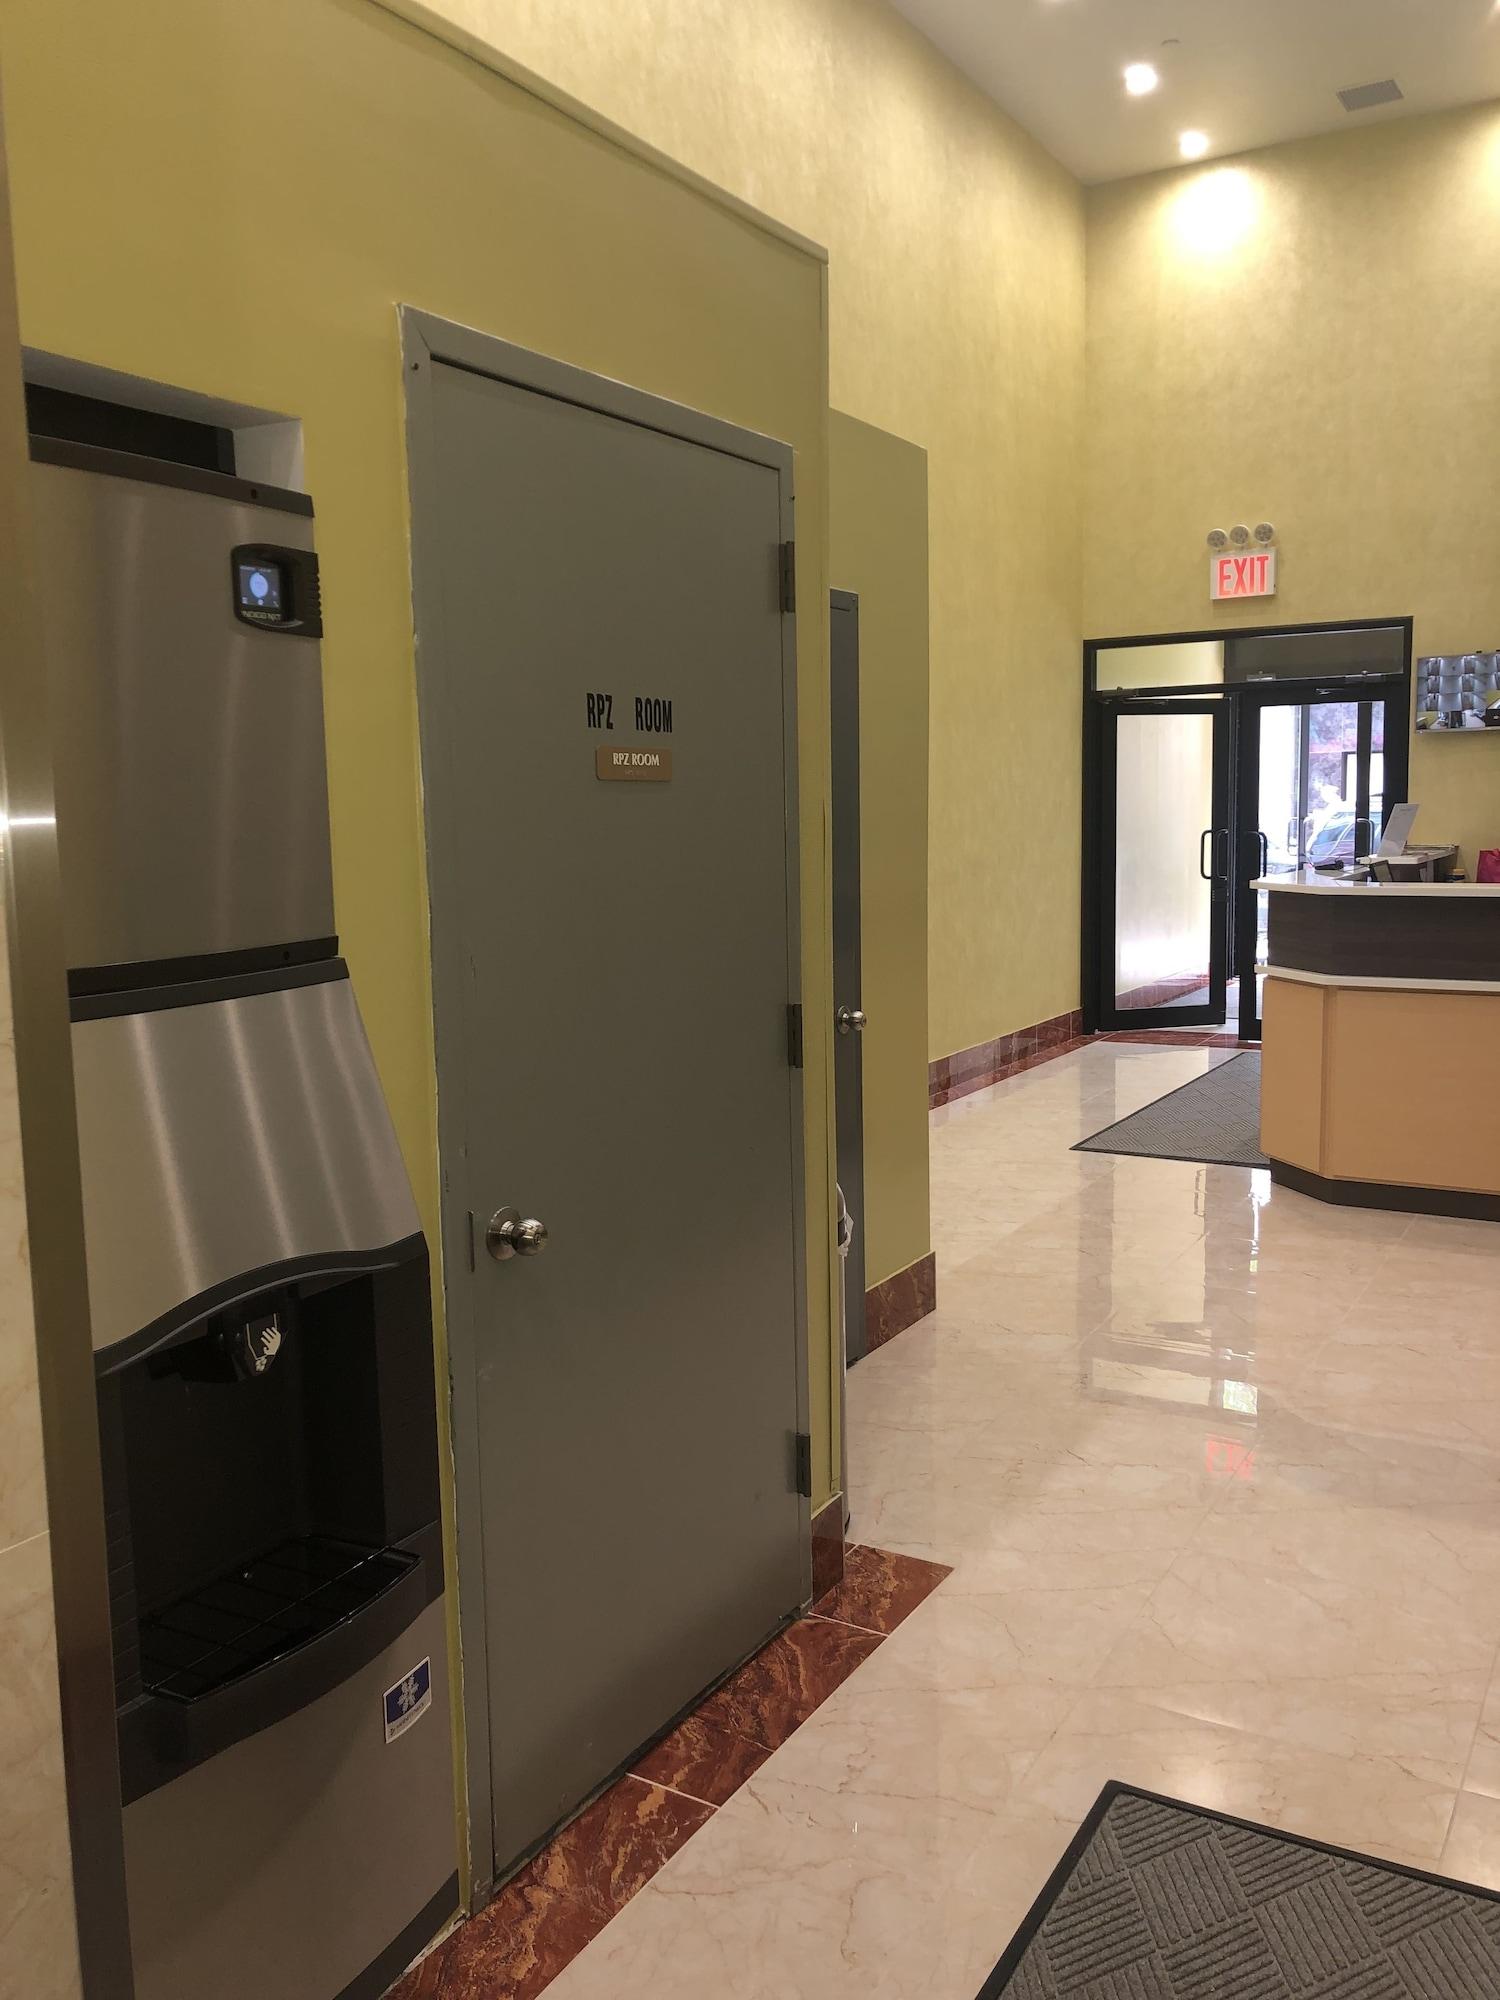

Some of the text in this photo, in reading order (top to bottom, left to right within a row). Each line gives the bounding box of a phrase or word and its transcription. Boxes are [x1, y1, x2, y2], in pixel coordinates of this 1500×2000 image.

[1219, 555, 1269, 596] EXIT
[586, 692, 672, 733] RPZ ROOM
[612, 752, 660, 767] RPZ ROOM
